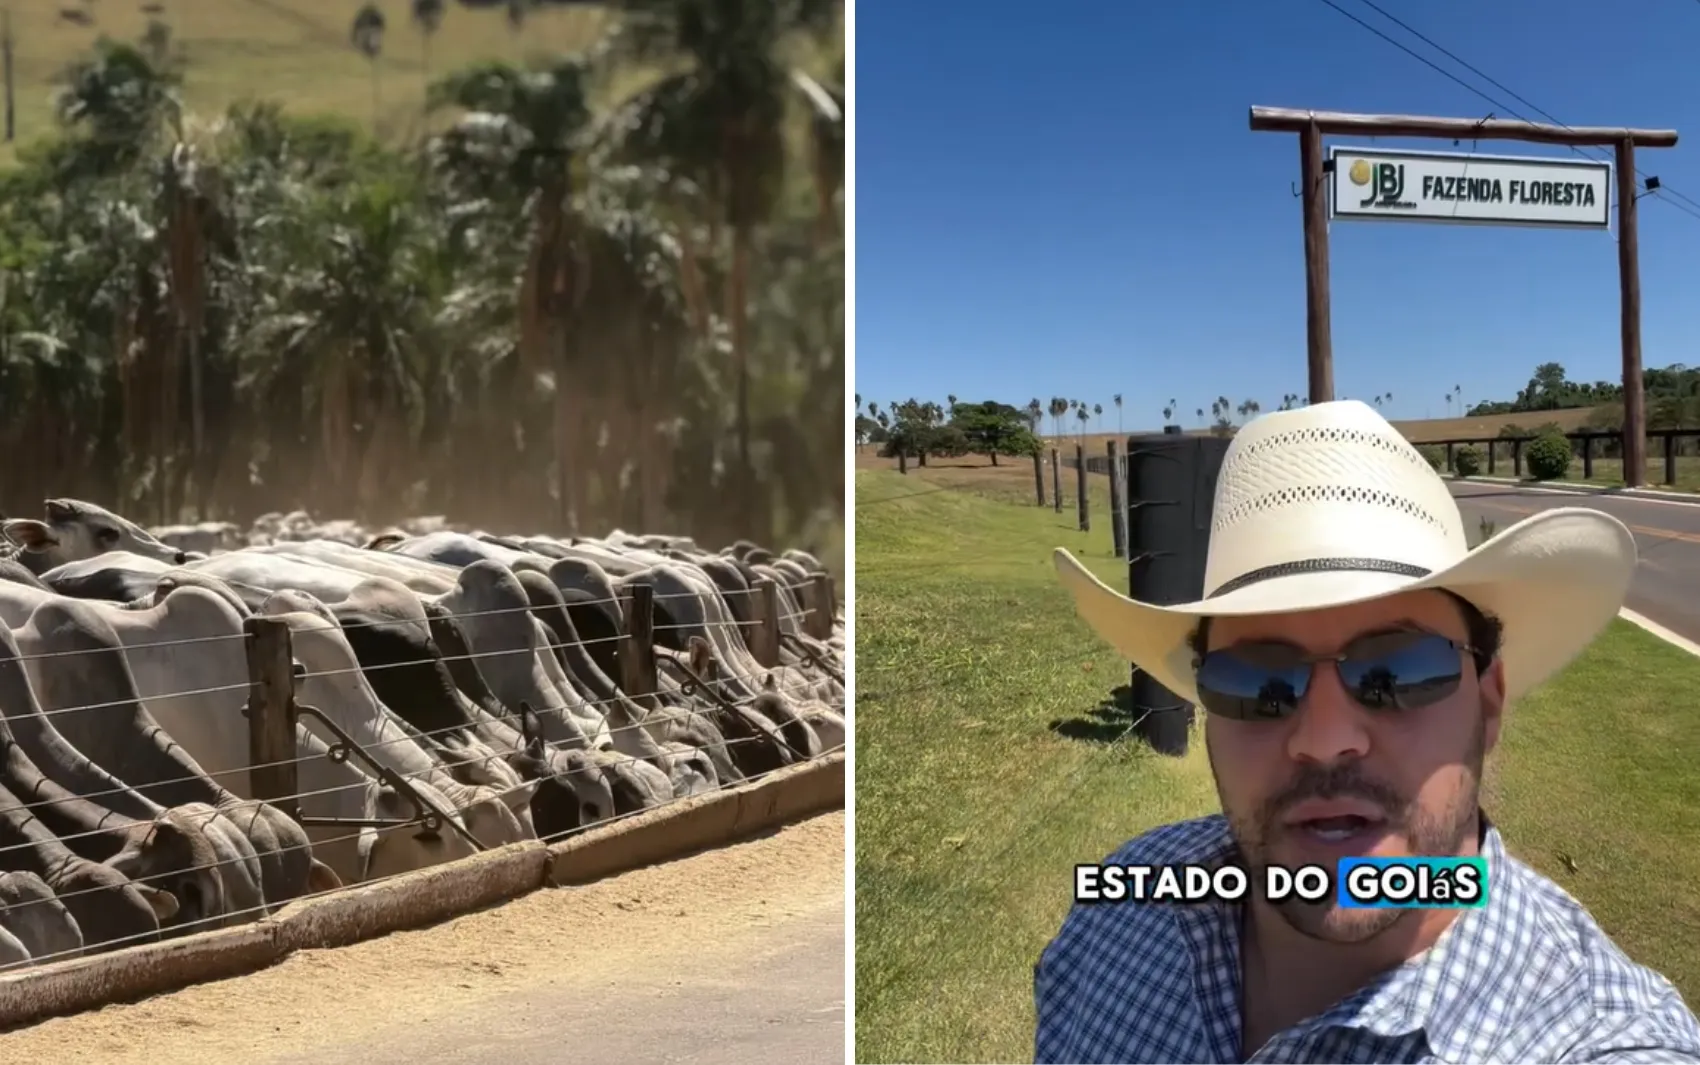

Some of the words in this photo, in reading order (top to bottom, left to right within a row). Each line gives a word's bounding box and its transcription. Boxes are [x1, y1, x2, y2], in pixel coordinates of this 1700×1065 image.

[1361, 163, 1404, 206] JBJ
[1422, 175, 1502, 203] FAZENDA
[1509, 180, 1595, 206] FLORESTA
